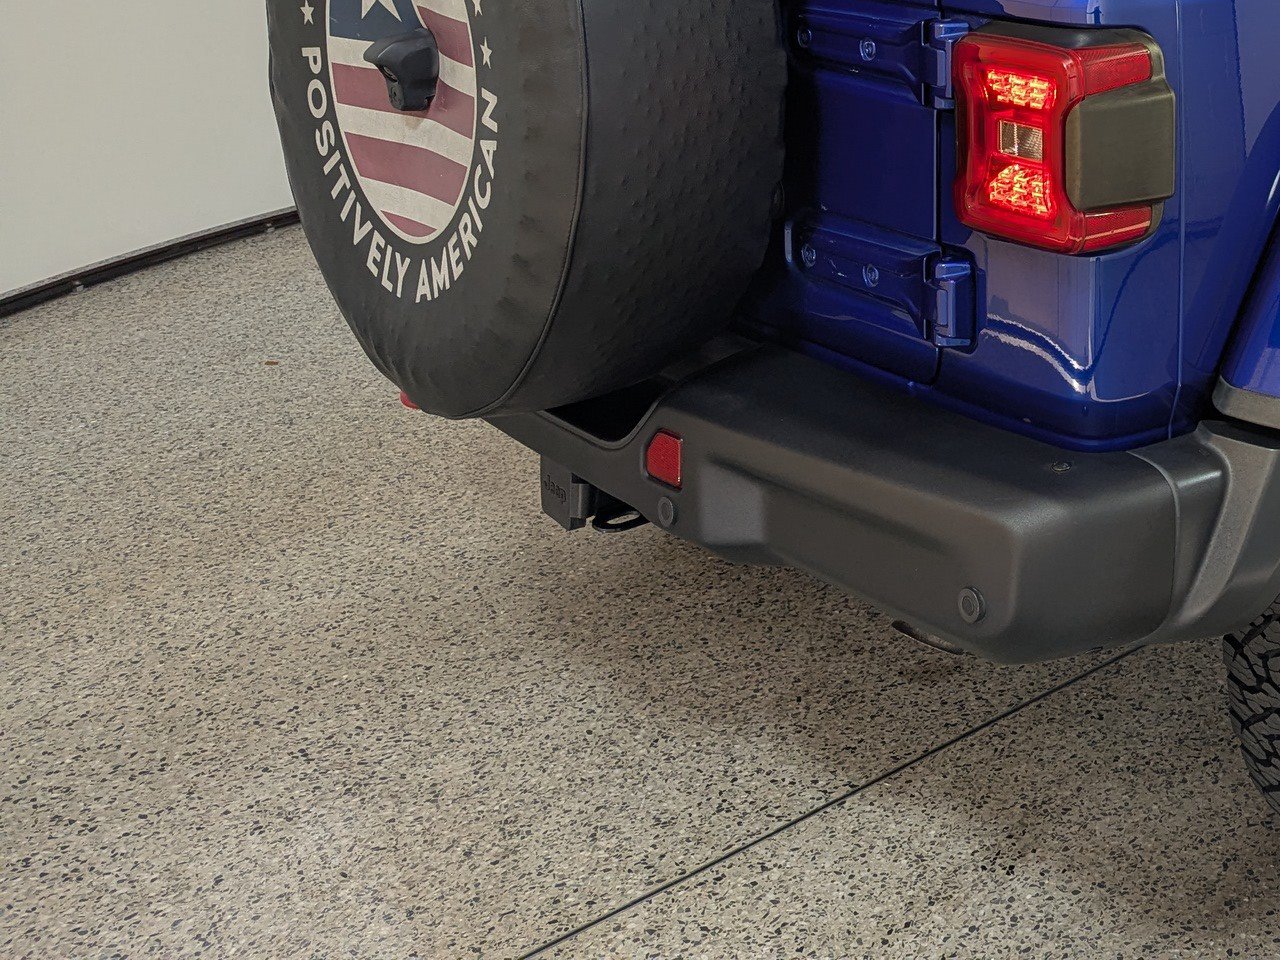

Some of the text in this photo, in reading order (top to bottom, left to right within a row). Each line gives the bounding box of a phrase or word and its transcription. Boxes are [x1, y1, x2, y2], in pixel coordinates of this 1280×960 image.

[301, 46, 499, 304] POSITIVELY AMERICAN
[543, 473, 568, 505] Jeep
